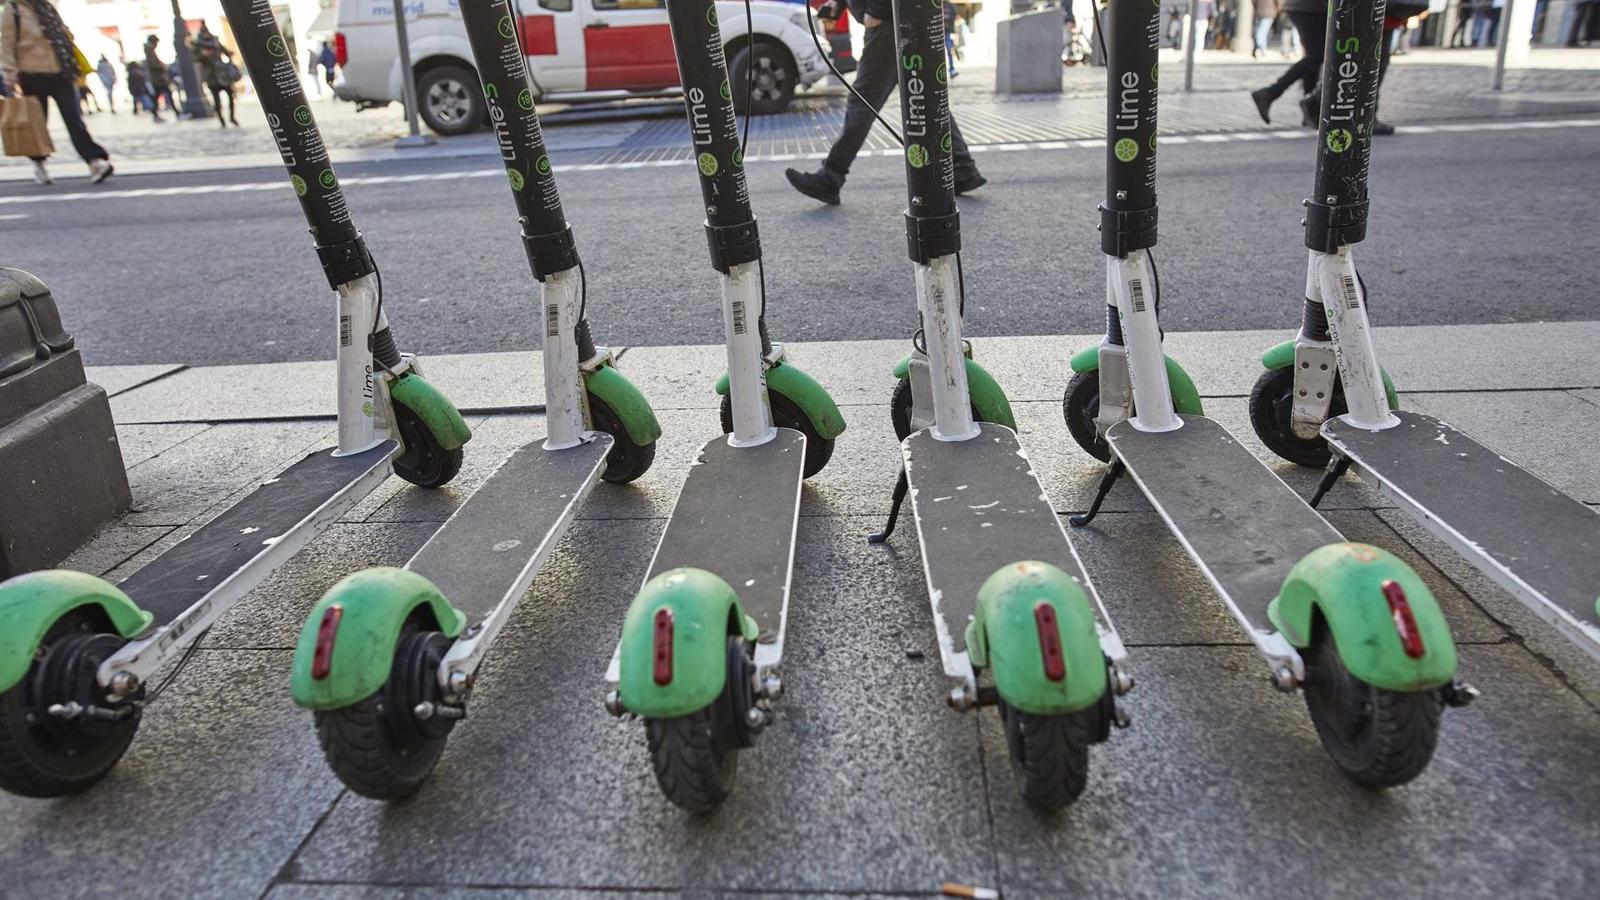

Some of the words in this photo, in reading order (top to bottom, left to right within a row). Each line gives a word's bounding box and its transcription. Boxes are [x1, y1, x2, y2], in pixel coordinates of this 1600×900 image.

[689, 87, 712, 145] Lime
[1116, 71, 1139, 130] Lime
[267, 112, 297, 167] Lime
[363, 364, 374, 399] Lime
